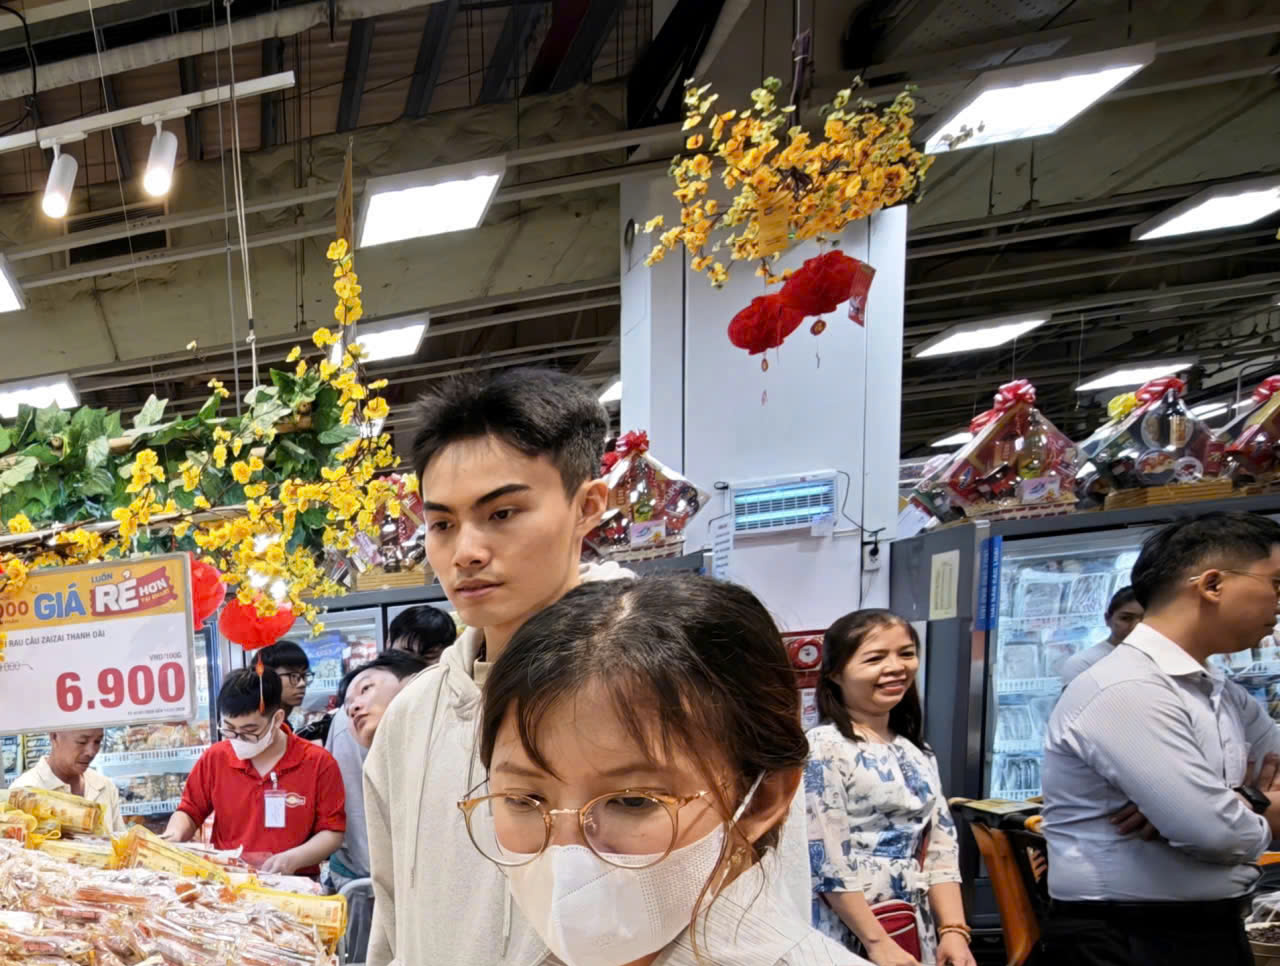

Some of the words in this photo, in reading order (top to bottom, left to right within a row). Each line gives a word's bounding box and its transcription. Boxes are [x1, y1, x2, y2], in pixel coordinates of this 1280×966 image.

[33, 582, 87, 621] GIÁ
[94, 569, 140, 613] RẺ
[139, 577, 168, 598] HƠN
[66, 630, 91, 643] THANH
[56, 661, 186, 713] 6.900
